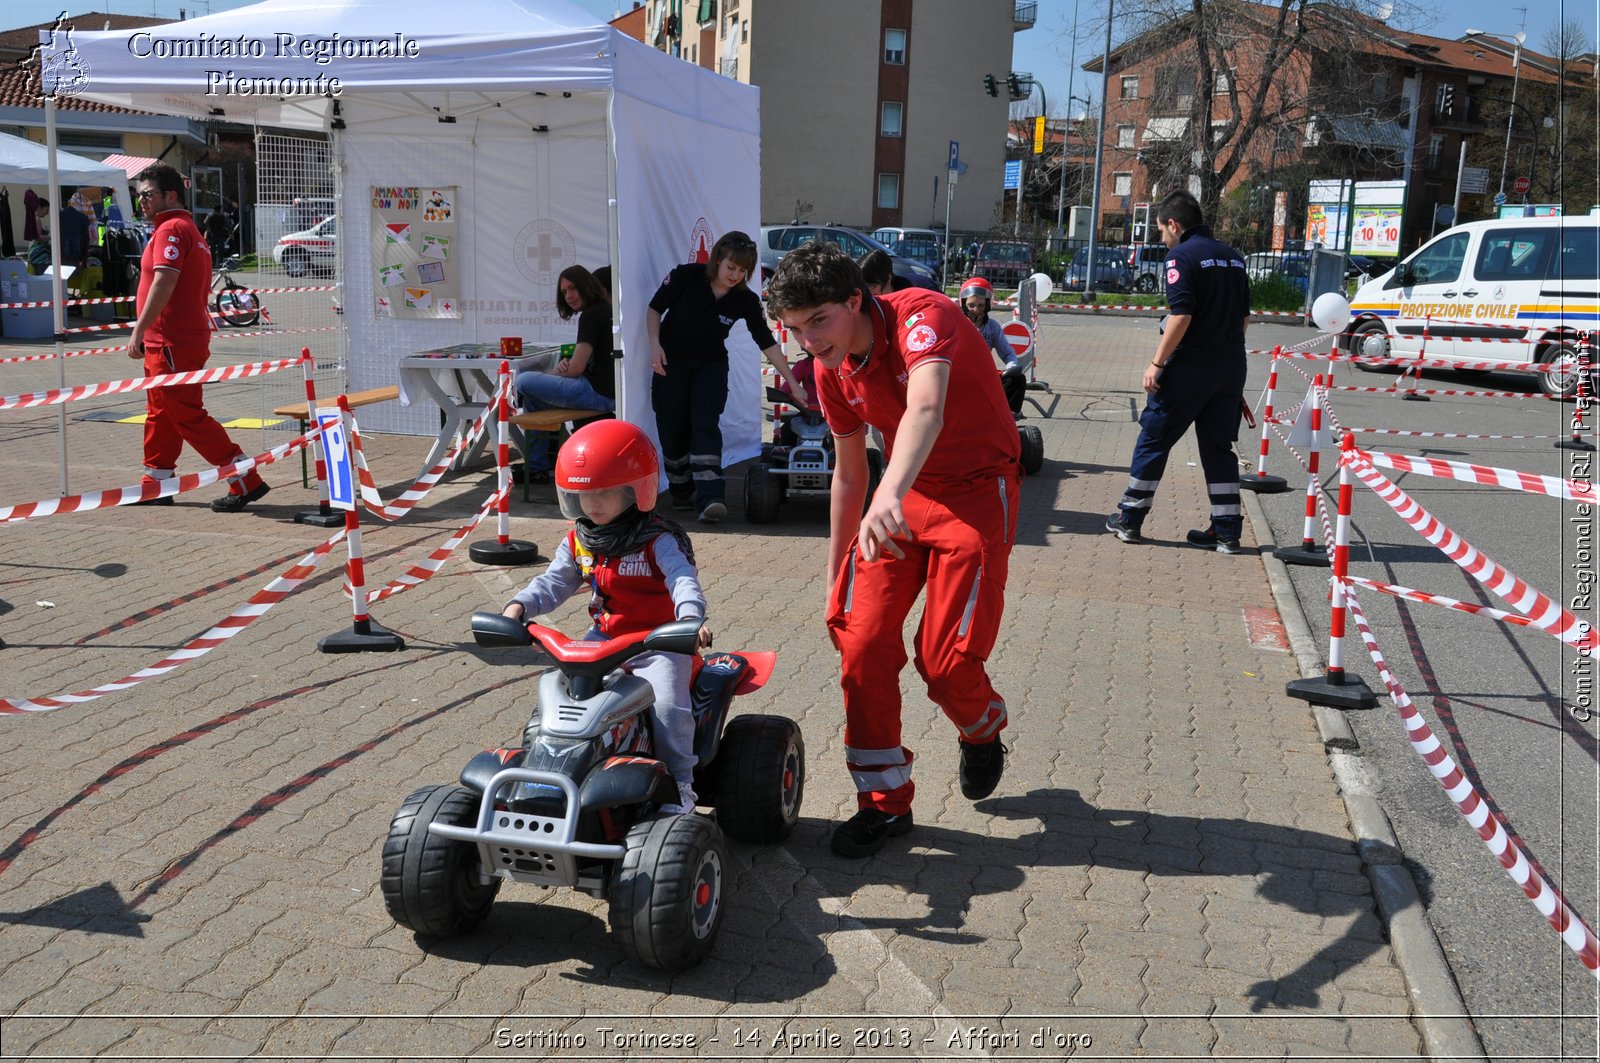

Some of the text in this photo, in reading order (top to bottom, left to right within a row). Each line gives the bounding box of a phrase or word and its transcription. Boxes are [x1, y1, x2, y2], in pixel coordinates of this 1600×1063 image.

[950, 143, 958, 167] P
[1515, 181, 1530, 189] STOP
[371, 199, 391, 209] CON
[1361, 227, 1374, 241] 10
[1385, 227, 1398, 241] 10
[1401, 303, 1519, 319] PROTEZIONE CIVILE
